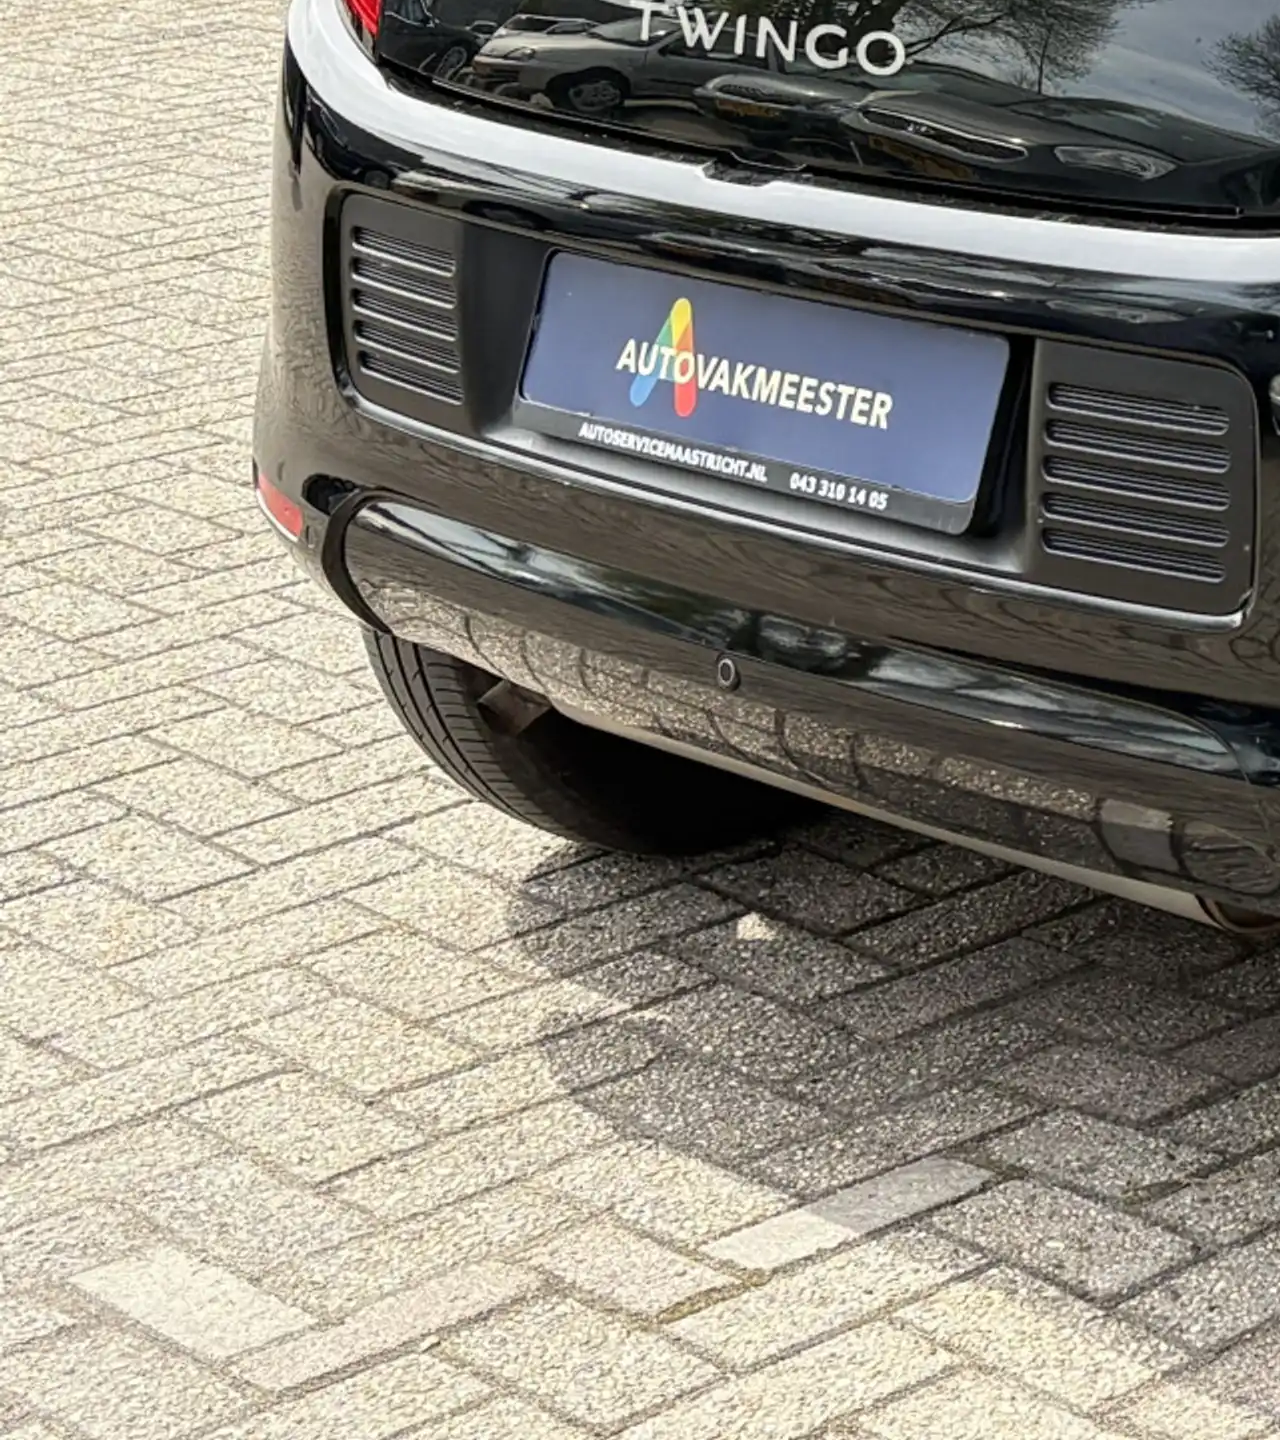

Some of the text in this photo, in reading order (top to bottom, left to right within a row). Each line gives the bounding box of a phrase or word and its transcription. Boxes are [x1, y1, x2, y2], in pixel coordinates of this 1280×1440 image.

[629, 0, 905, 76] TWINGO
[616, 339, 894, 429] AUTOVAKMEESTER
[579, 421, 768, 483] AUTOSERVICEMAASTRICHT.NL
[790, 472, 889, 510] 043 310 14 05
